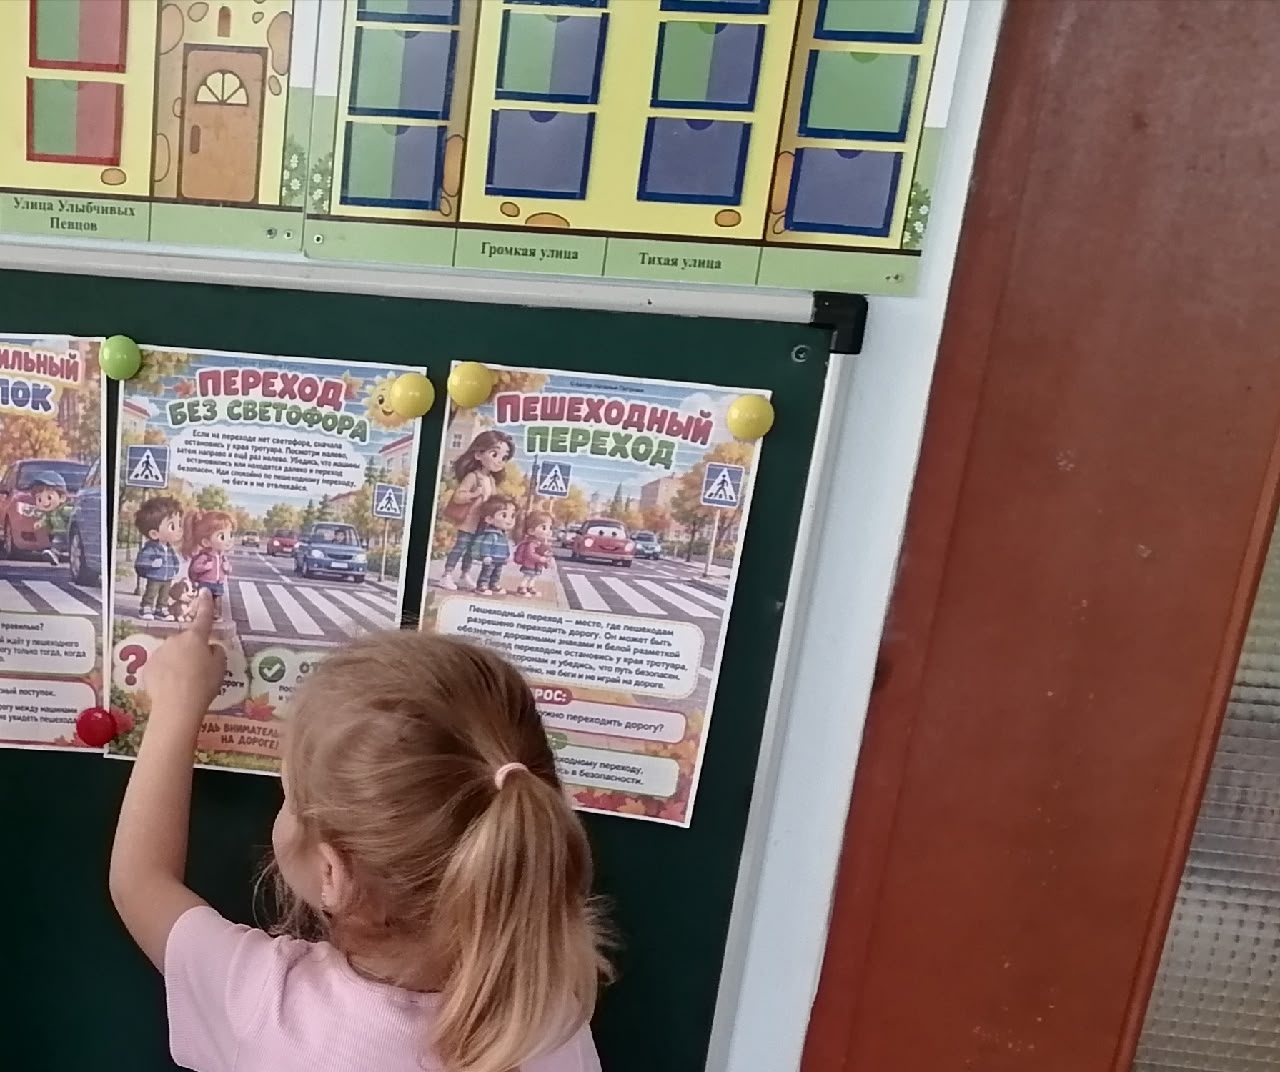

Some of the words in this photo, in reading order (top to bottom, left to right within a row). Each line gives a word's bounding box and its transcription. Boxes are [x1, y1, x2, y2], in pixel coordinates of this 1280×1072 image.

[13, 197, 54, 212] Улица
[58, 199, 136, 217] Улыбчивых
[50, 216, 98, 232] Певцов
[481, 241, 536, 258] Громкая
[540, 248, 579, 262] улица
[639, 252, 679, 268] Тихая
[681, 257, 722, 271] улица
[199, 370, 345, 411] ПЕРЕХОД
[169, 399, 218, 426] БЕЗ
[226, 400, 368, 442] СВЕТОФОРА
[496, 394, 713, 446] ПЕШЕХОДНЫЙ
[526, 426, 677, 470] ПЕРЕХОД
[1, 622, 44, 632] правильно?
[469, 604, 525, 618] Пешеходный
[527, 613, 563, 624] переход
[575, 620, 603, 629] место,
[606, 622, 621, 631] где
[623, 624, 674, 636] пешеходам
[457, 624, 502, 637] обозначен
[503, 631, 556, 643] дорожными
[558, 639, 595, 648] знаками
[604, 642, 631, 652] белой
[632, 647, 681, 658] разметкой
[466, 616, 515, 627] разрешено
[516, 622, 566, 635] переходить
[568, 629, 600, 640] дорогу.
[604, 632, 617, 640] Он
[619, 635, 648, 644] может
[650, 637, 672, 647] быть
[64, 650, 87, 658] когда
[514, 643, 562, 655] переходом
[564, 650, 613, 661] остановись
[623, 657, 643, 665] края
[119, 644, 147, 686] ?
[599, 664, 613, 672] что
[615, 666, 633, 675] путь
[557, 669, 577, 678] беги
[597, 676, 621, 684] играй
[201, 722, 221, 734] УДЬ
[566, 714, 622, 728] переходить
[624, 721, 664, 734] дорогу?
[221, 735, 234, 744] НА
[237, 735, 279, 750] ДОРОГЕ!
